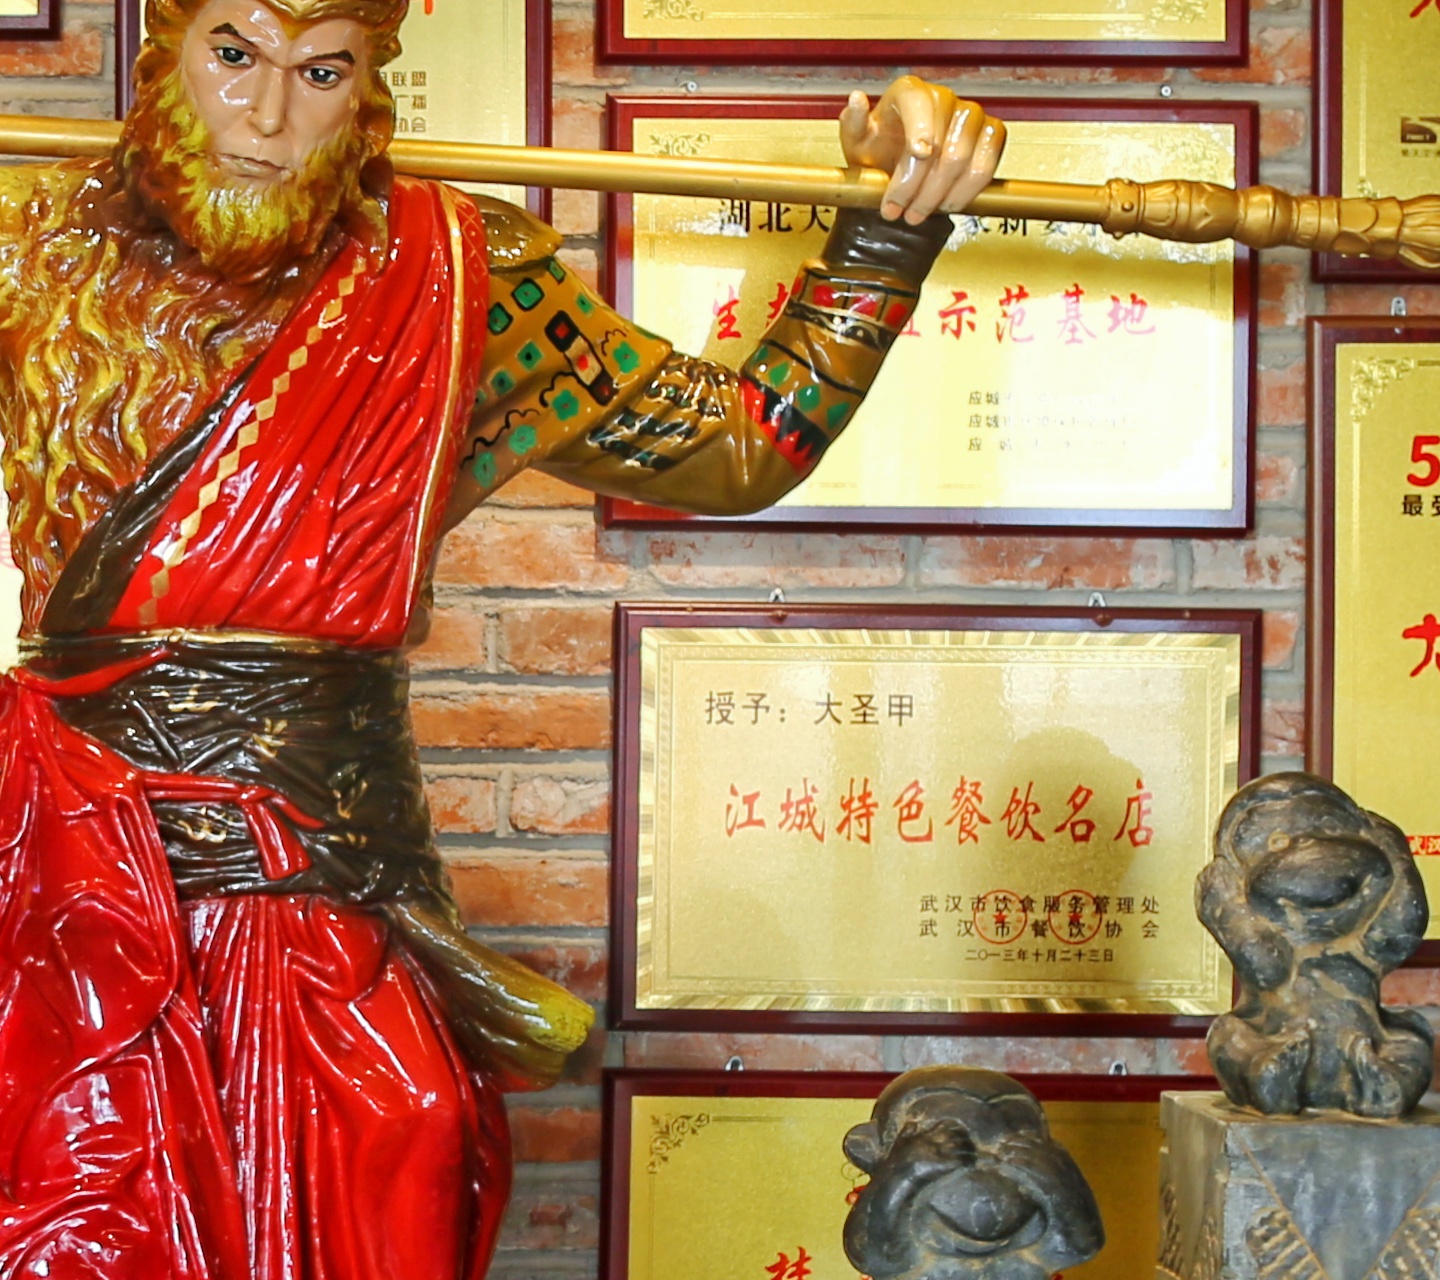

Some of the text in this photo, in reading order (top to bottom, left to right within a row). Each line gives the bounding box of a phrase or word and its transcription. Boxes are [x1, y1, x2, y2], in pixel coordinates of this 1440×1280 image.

[813, 692, 916, 728] 大圣甲
[725, 774, 1156, 848] 江城特色餐饮名店
[919, 893, 1160, 915] 武汉市饮食服务管理处
[919, 919, 1160, 939] 武汉市餐饮协会
